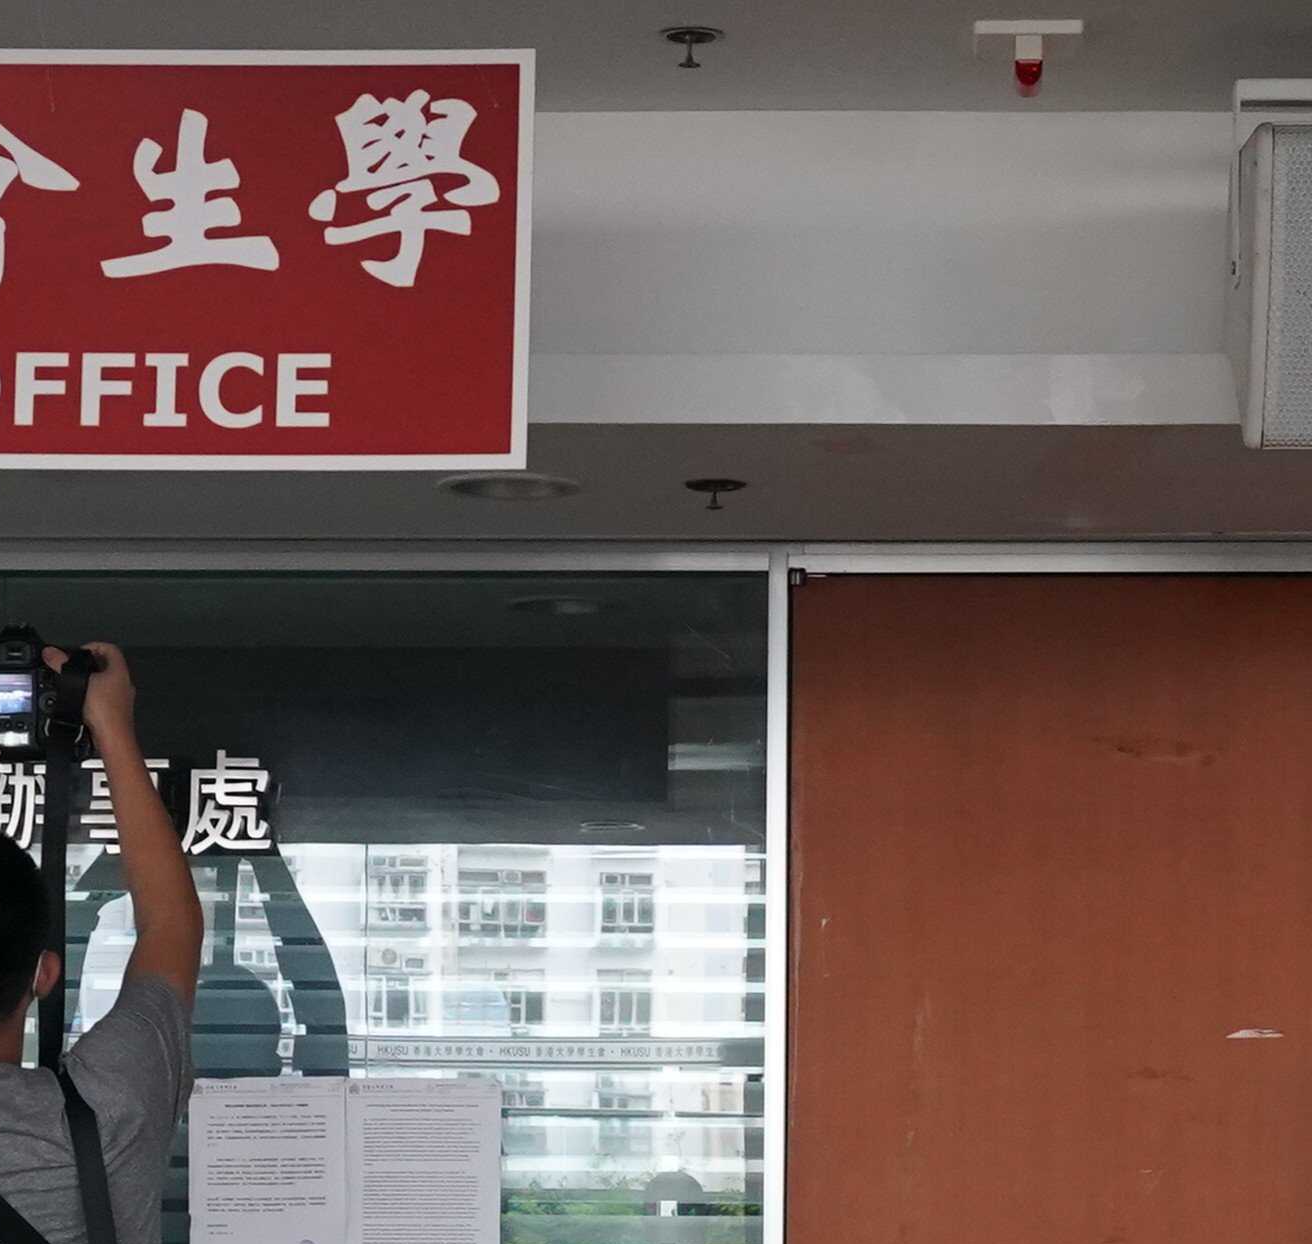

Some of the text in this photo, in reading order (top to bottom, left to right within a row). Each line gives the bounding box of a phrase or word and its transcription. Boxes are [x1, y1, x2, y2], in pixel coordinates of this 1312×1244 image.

[377, 1045, 409, 1056] HKUSU
[499, 1045, 530, 1057] HKUSU
[620, 1046, 650, 1058] HKUSU
